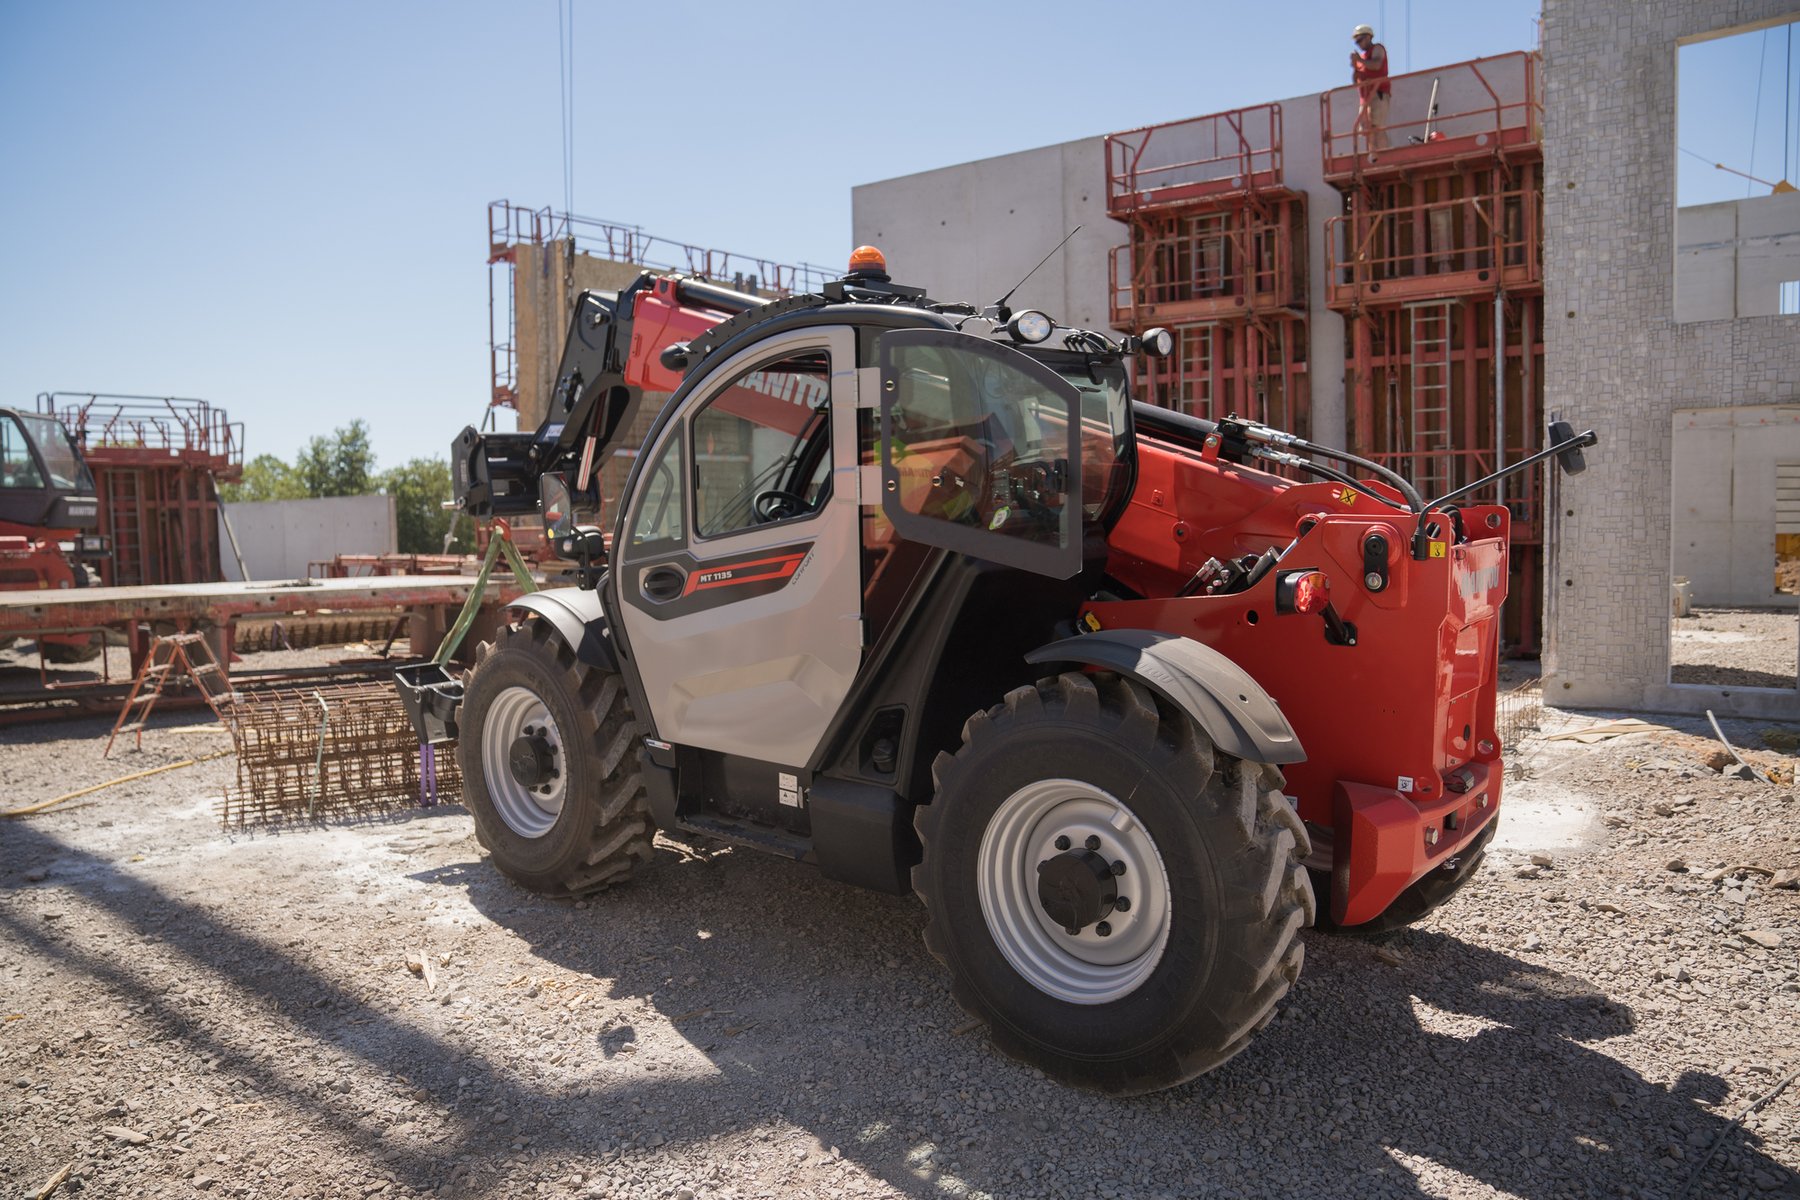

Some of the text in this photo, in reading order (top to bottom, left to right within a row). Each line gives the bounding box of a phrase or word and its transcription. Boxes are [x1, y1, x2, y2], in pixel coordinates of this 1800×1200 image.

[737, 371, 829, 410] ANITO
[700, 570, 732, 583] MT 1135
